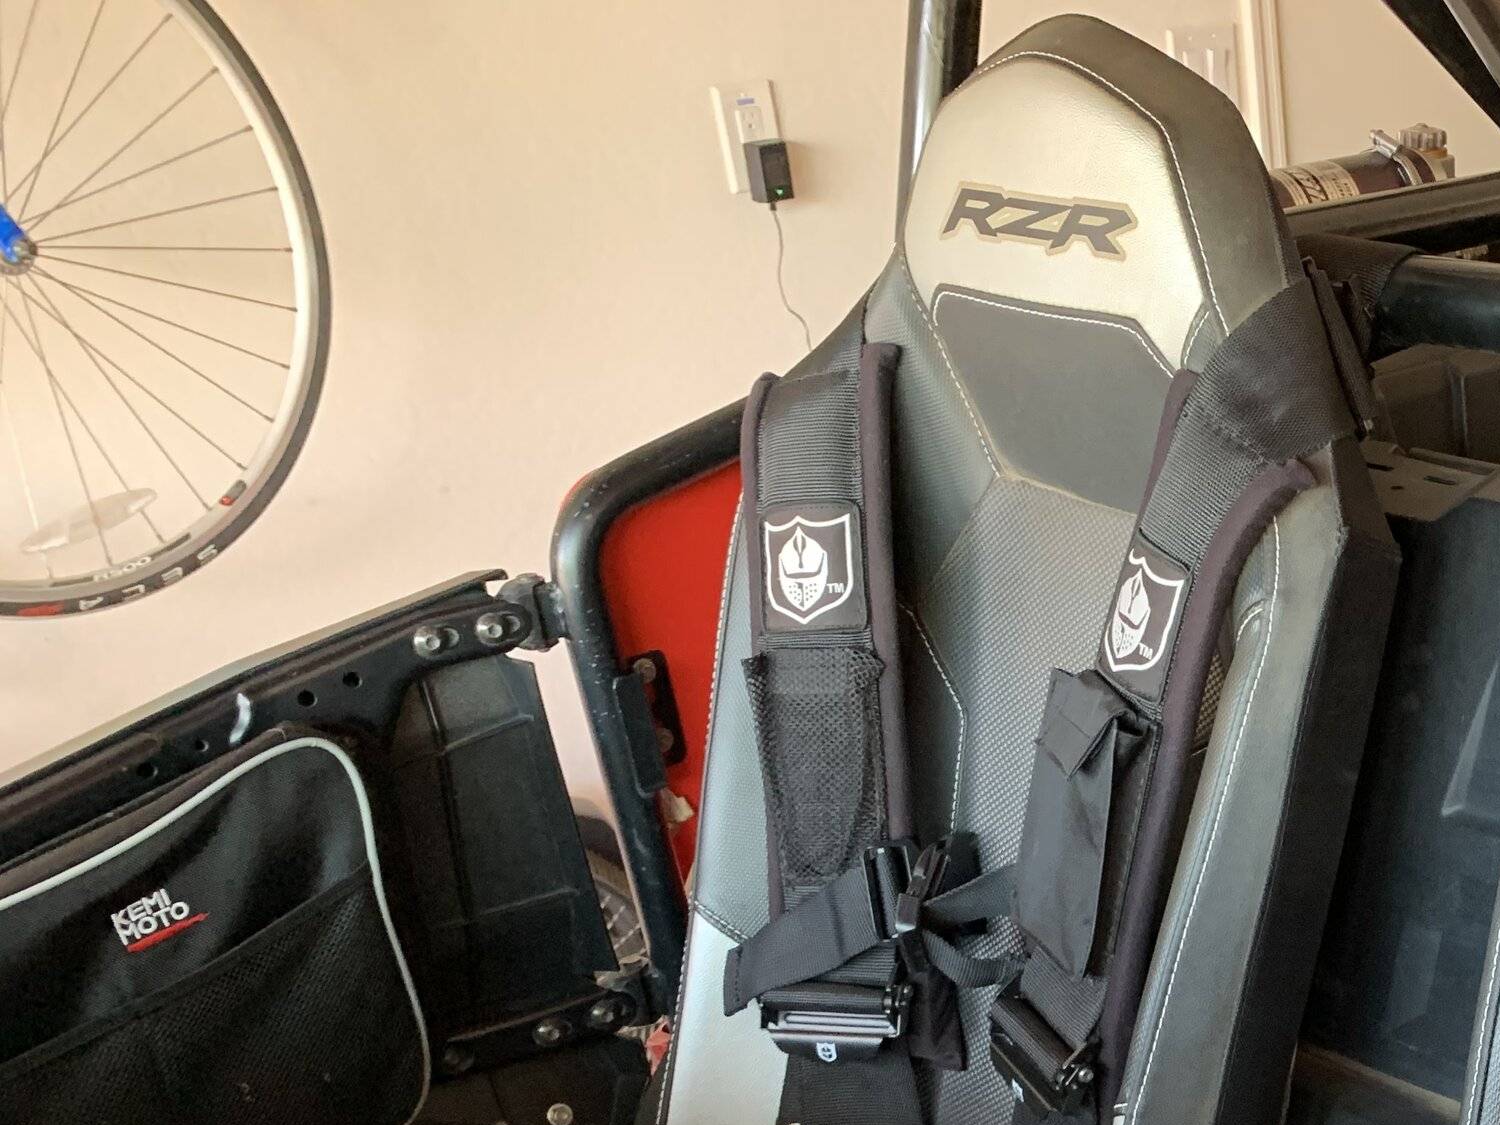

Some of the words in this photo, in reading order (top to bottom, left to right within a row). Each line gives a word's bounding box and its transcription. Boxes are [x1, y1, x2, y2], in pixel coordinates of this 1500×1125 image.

[940, 185, 1135, 258] RZR
[826, 582, 845, 594] TM
[110, 888, 171, 922] KEMI
[116, 901, 189, 946] MOTO
